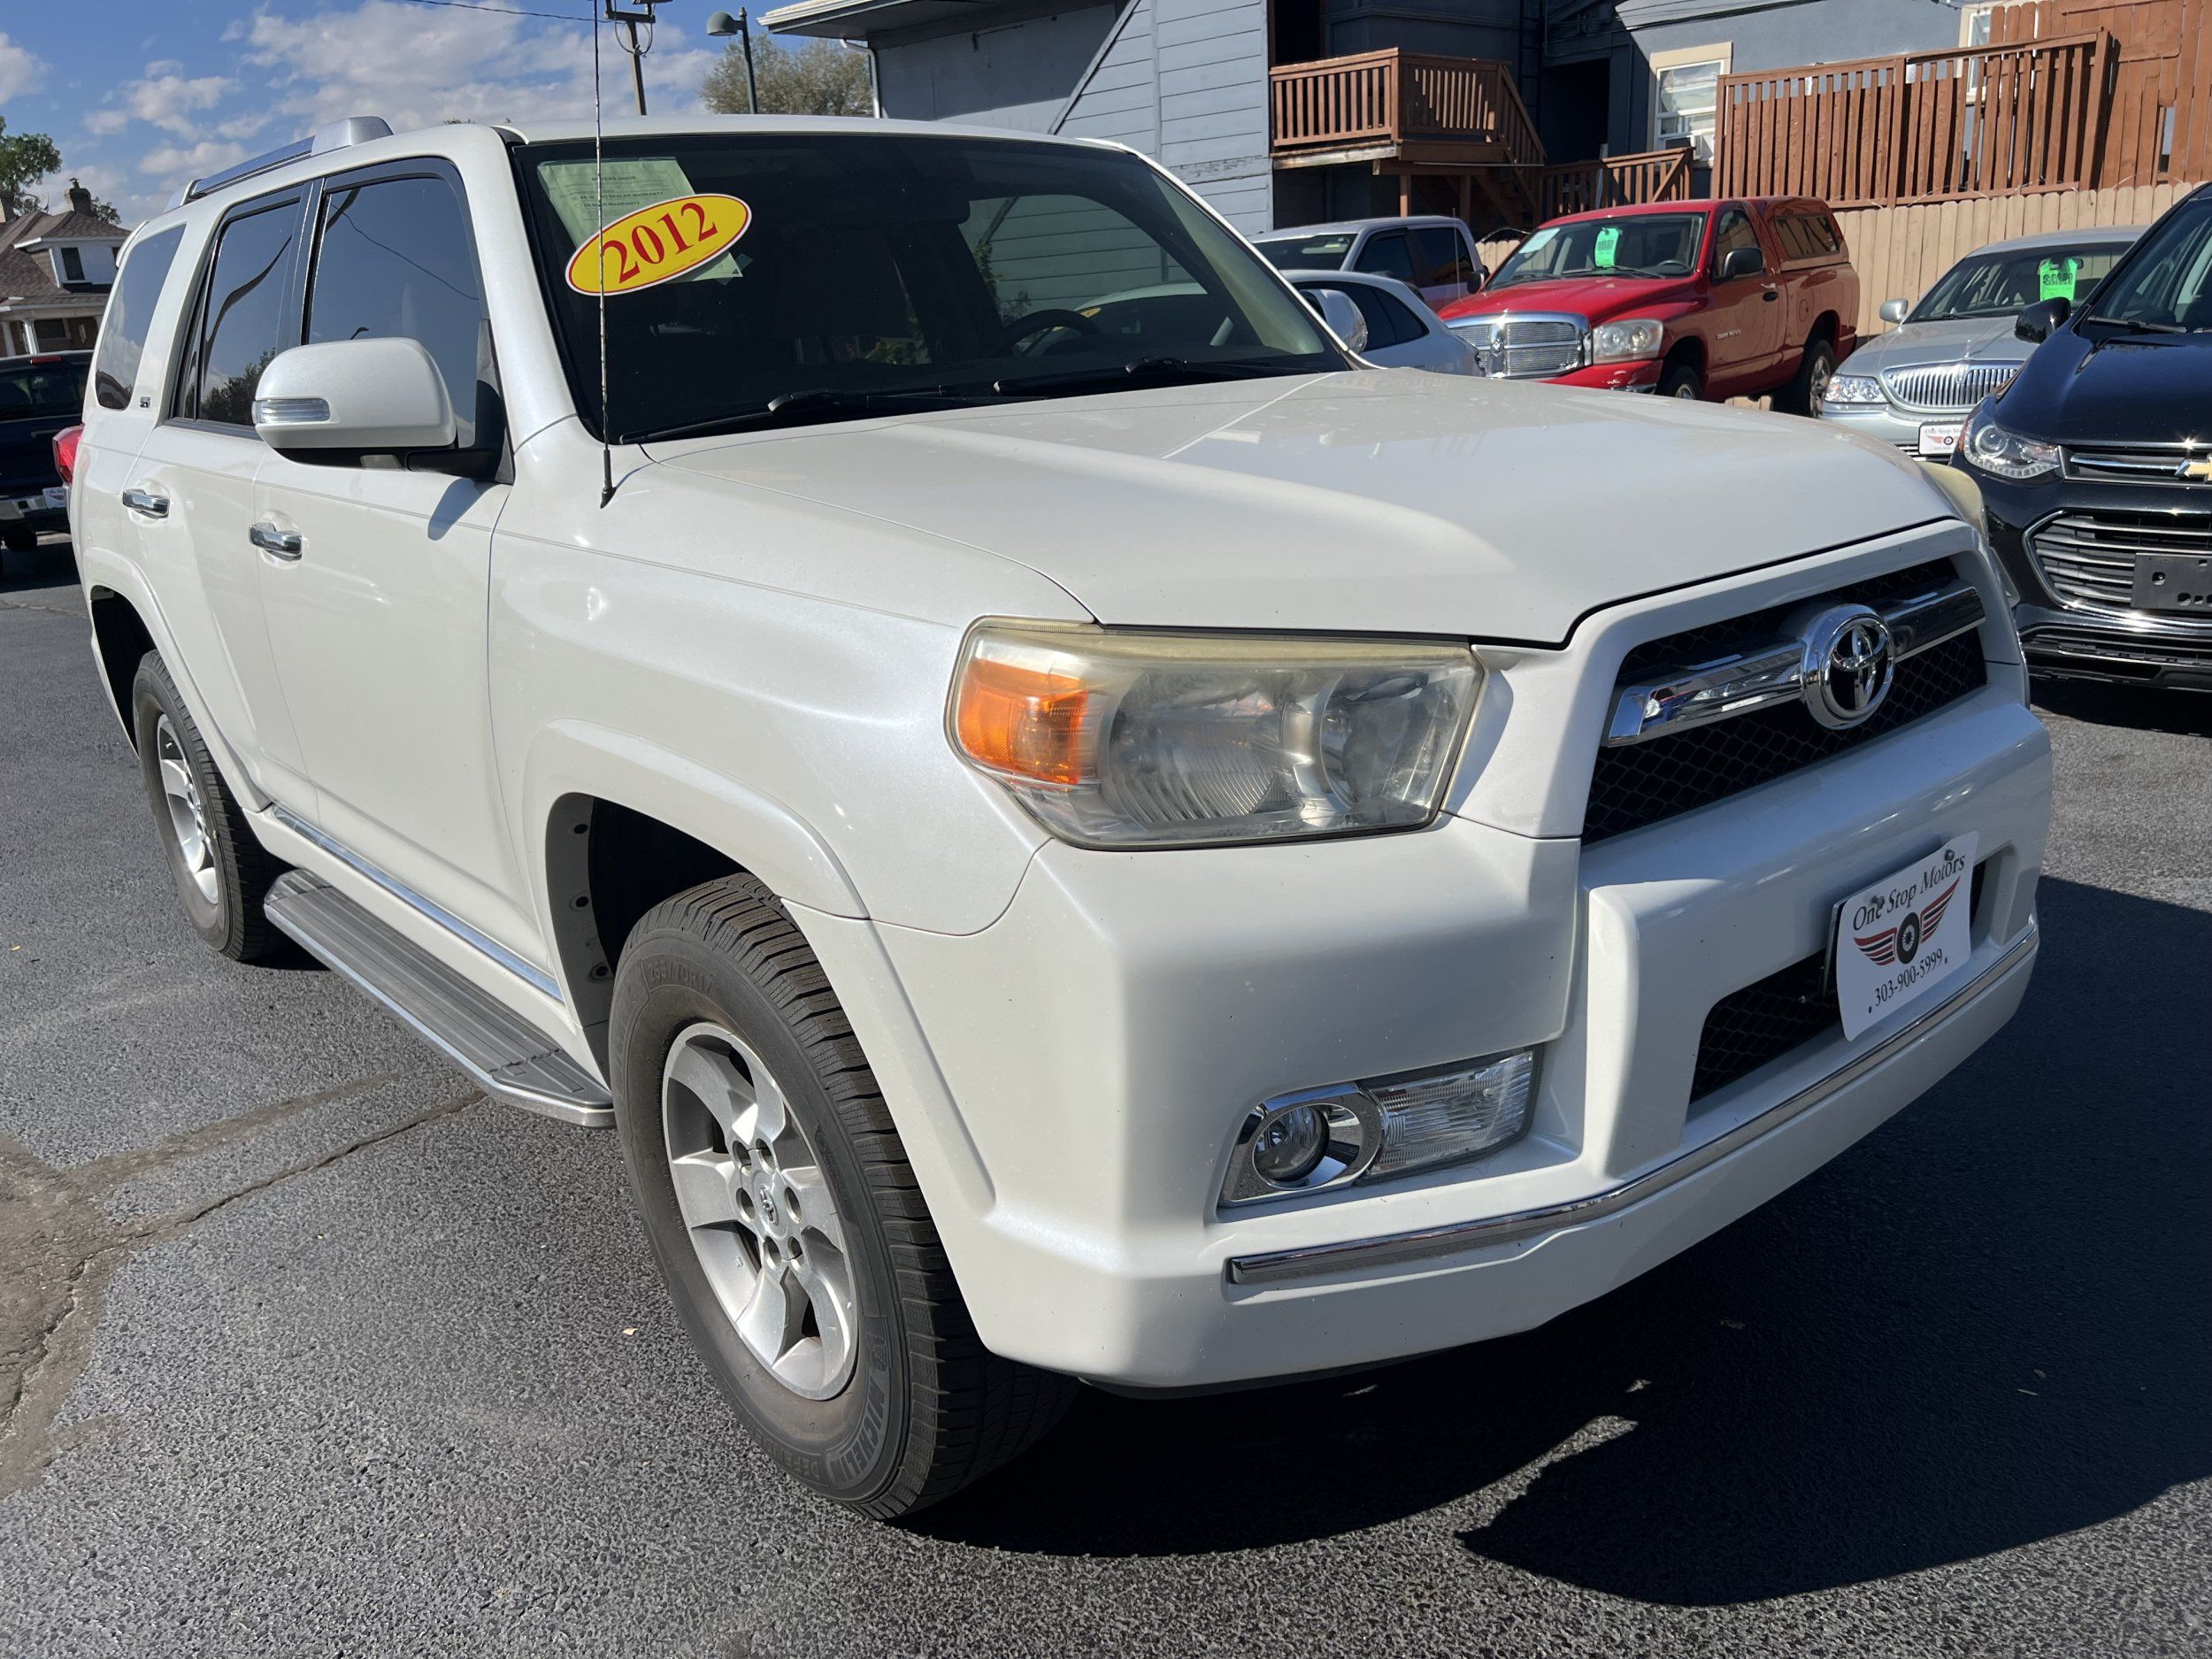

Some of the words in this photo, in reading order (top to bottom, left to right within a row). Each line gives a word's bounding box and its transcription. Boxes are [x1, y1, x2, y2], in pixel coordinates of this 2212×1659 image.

[602, 203, 718, 283] 2012
[1853, 902, 1884, 931] One
[1886, 884, 1917, 914] Stop
[1919, 855, 1965, 895] Motors
[1874, 948, 1943, 1007] 303-900-5999
[830, 1376, 885, 1486] MICHELIN
